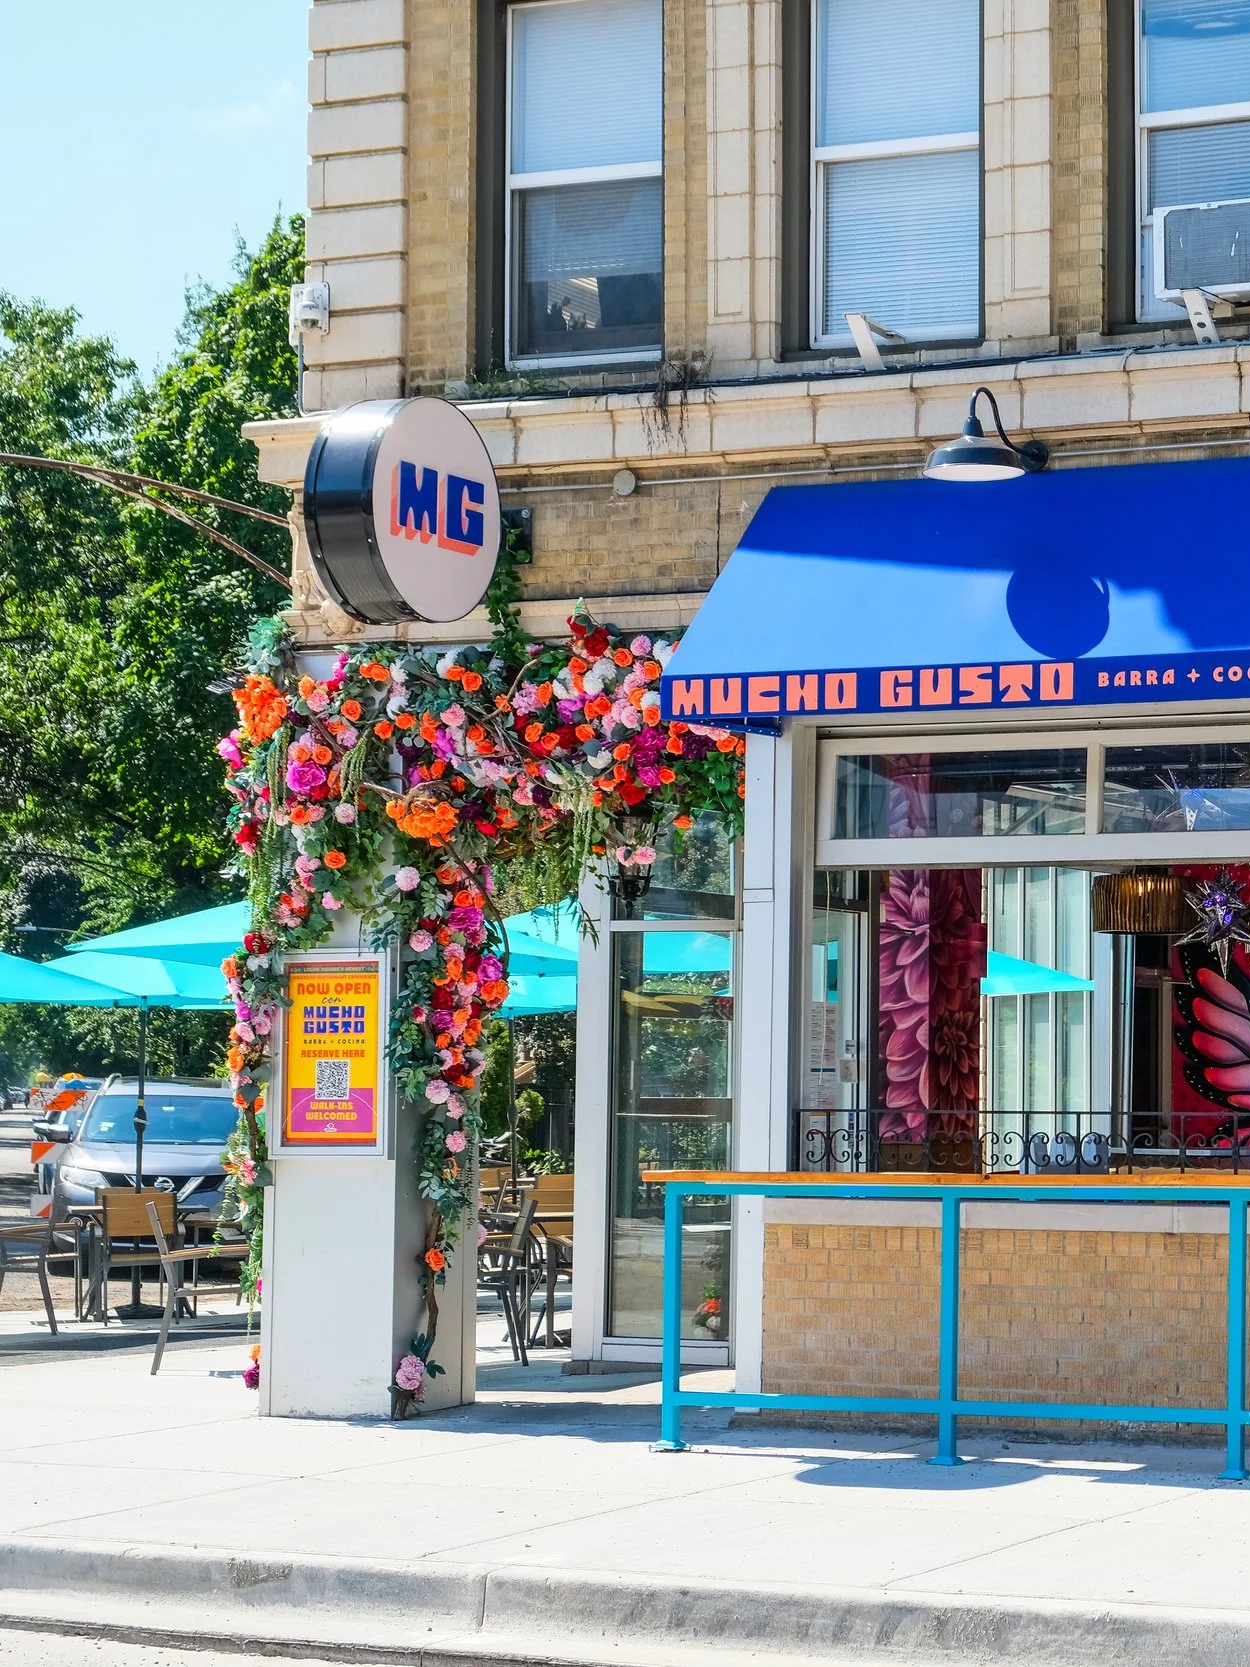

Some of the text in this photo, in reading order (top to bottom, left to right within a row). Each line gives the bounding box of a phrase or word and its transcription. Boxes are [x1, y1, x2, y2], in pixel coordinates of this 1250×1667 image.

[390, 460, 484, 556] MG
[672, 672, 857, 716] MUCHO
[879, 662, 1074, 708] GUSTO
[1097, 669, 1175, 688] BARRA
[297, 982, 371, 996] NOW OPEN
[303, 1005, 365, 1019] MUCHO
[303, 1021, 365, 1034] GUSTO
[301, 1049, 366, 1058] RESERVE HERE
[310, 1101, 354, 1110] WALK-INS
[305, 1111, 358, 1121] WELCOMED
